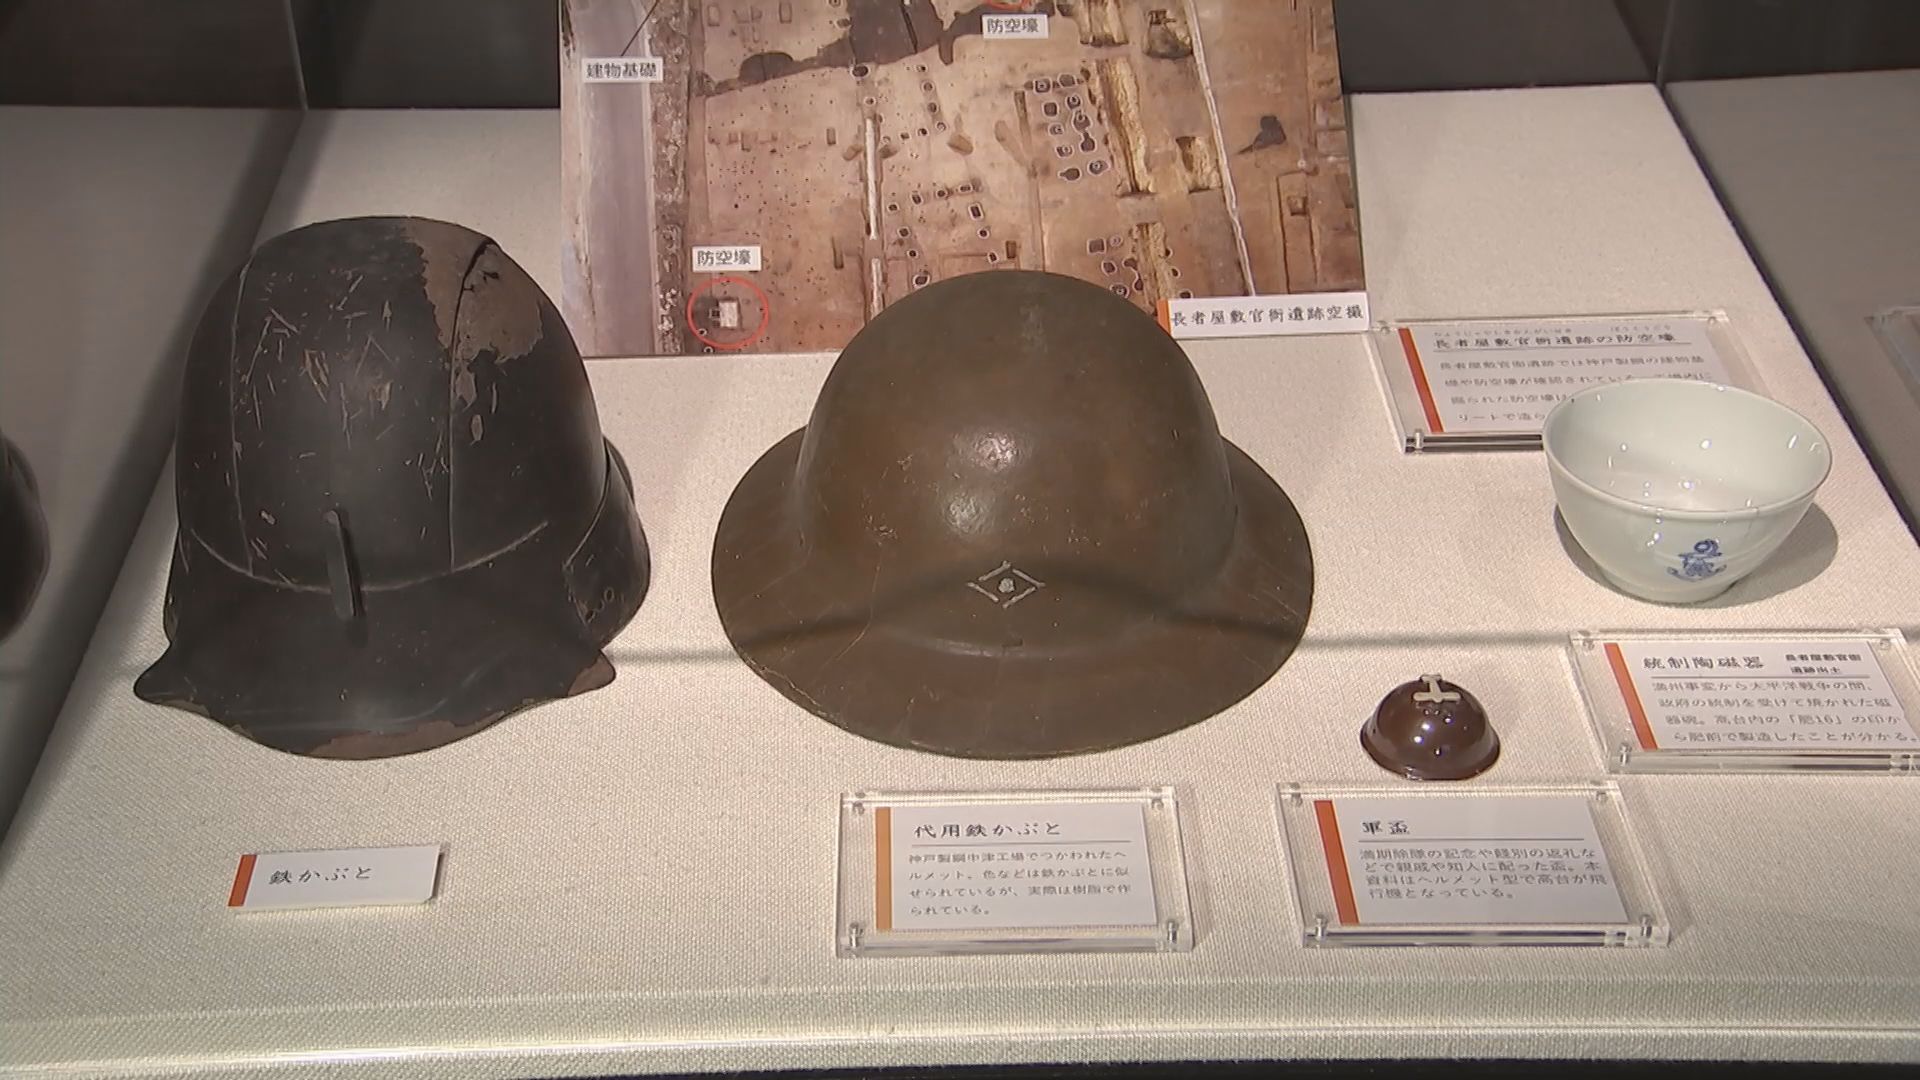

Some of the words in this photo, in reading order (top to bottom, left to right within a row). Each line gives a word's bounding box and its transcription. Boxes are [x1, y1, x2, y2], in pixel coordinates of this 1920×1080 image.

[987, 18, 1039, 34] 防空壕
[586, 62, 657, 78] 建物基礎
[697, 249, 751, 266] 防空壕
[1643, 656, 1764, 670] 統制陶磁器
[914, 822, 1061, 839] 代用鉄かぶと
[269, 867, 371, 884] 鉄かぶと
[911, 904, 990, 916] られている。
